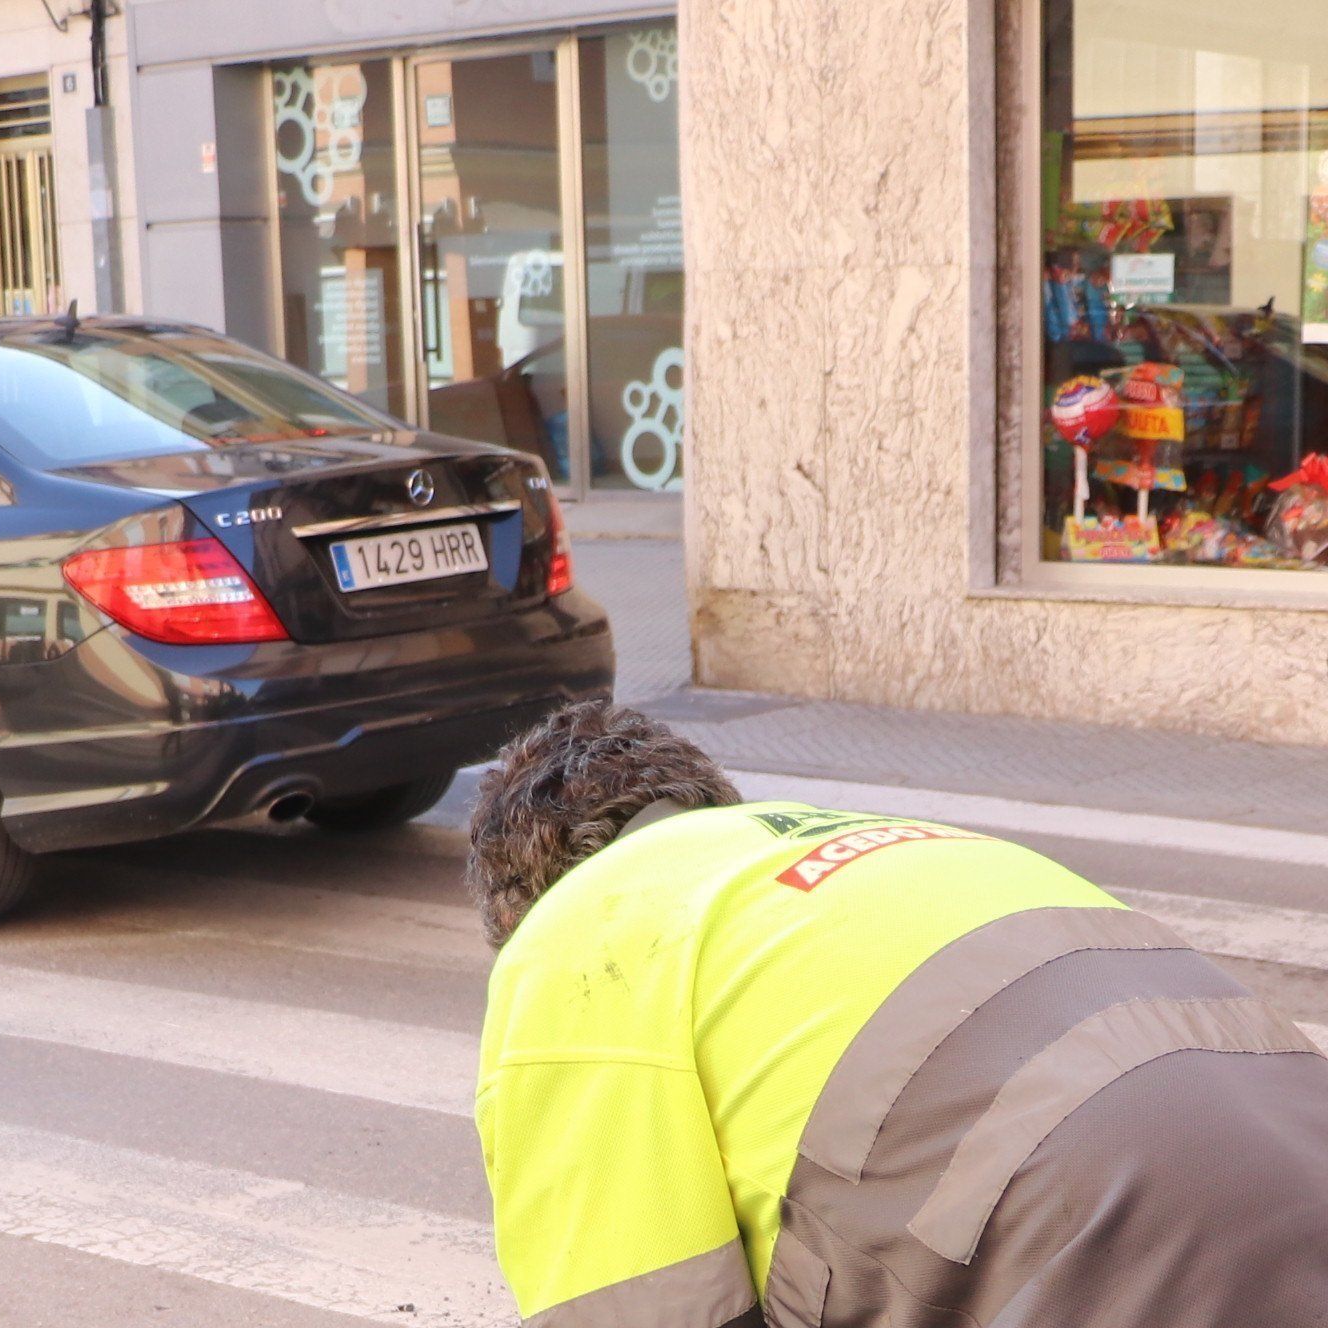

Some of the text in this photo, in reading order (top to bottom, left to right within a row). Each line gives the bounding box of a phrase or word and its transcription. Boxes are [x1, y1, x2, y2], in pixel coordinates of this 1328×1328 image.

[215, 505, 283, 528] C 200
[357, 537, 424, 580] 1429
[430, 530, 481, 570] HRR
[793, 826, 928, 886] ACEDO
